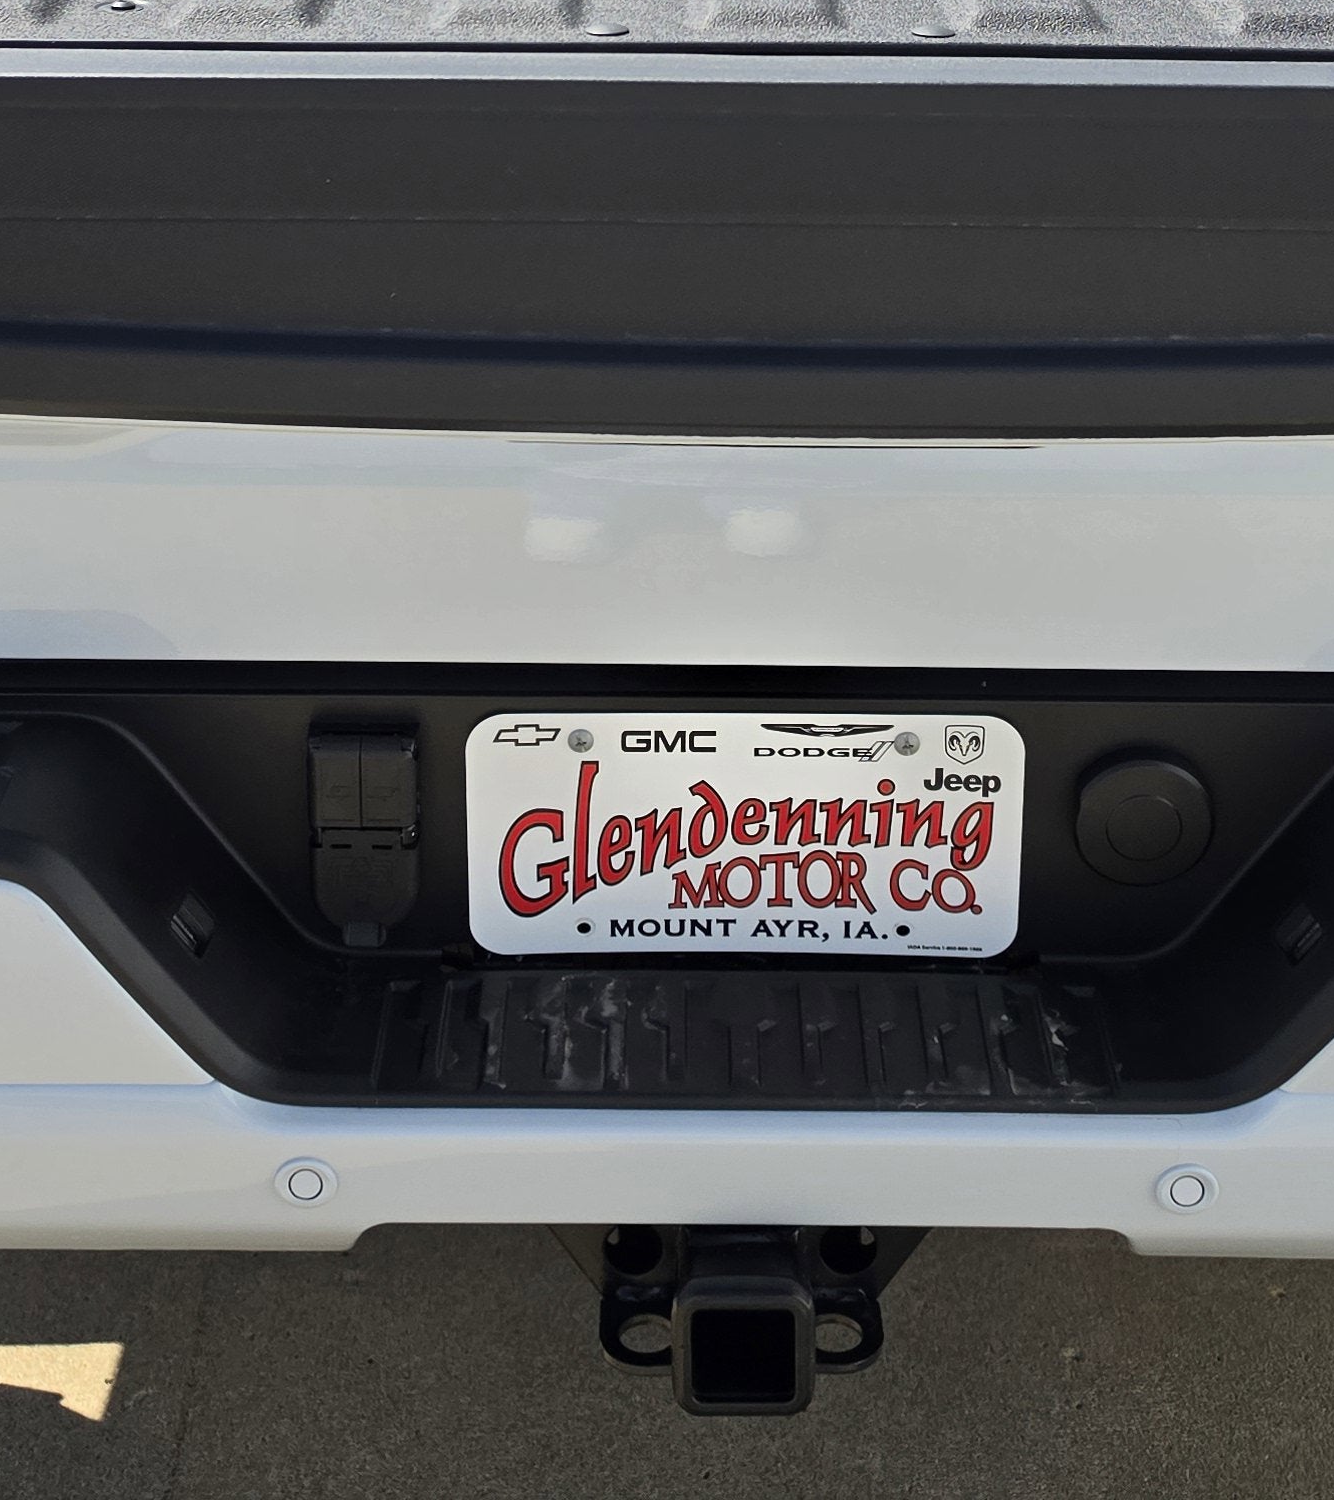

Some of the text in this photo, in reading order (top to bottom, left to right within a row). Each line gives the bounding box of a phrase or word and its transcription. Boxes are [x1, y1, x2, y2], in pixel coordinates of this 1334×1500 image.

[620, 730, 717, 753] GMC
[753, 747, 873, 758] DODGE
[923, 767, 1002, 798] Jeep
[498, 760, 995, 918] Glendenning
[669, 849, 983, 914] MOTOR CO.
[609, 919, 889, 943] MOUNT AYR, IA.
